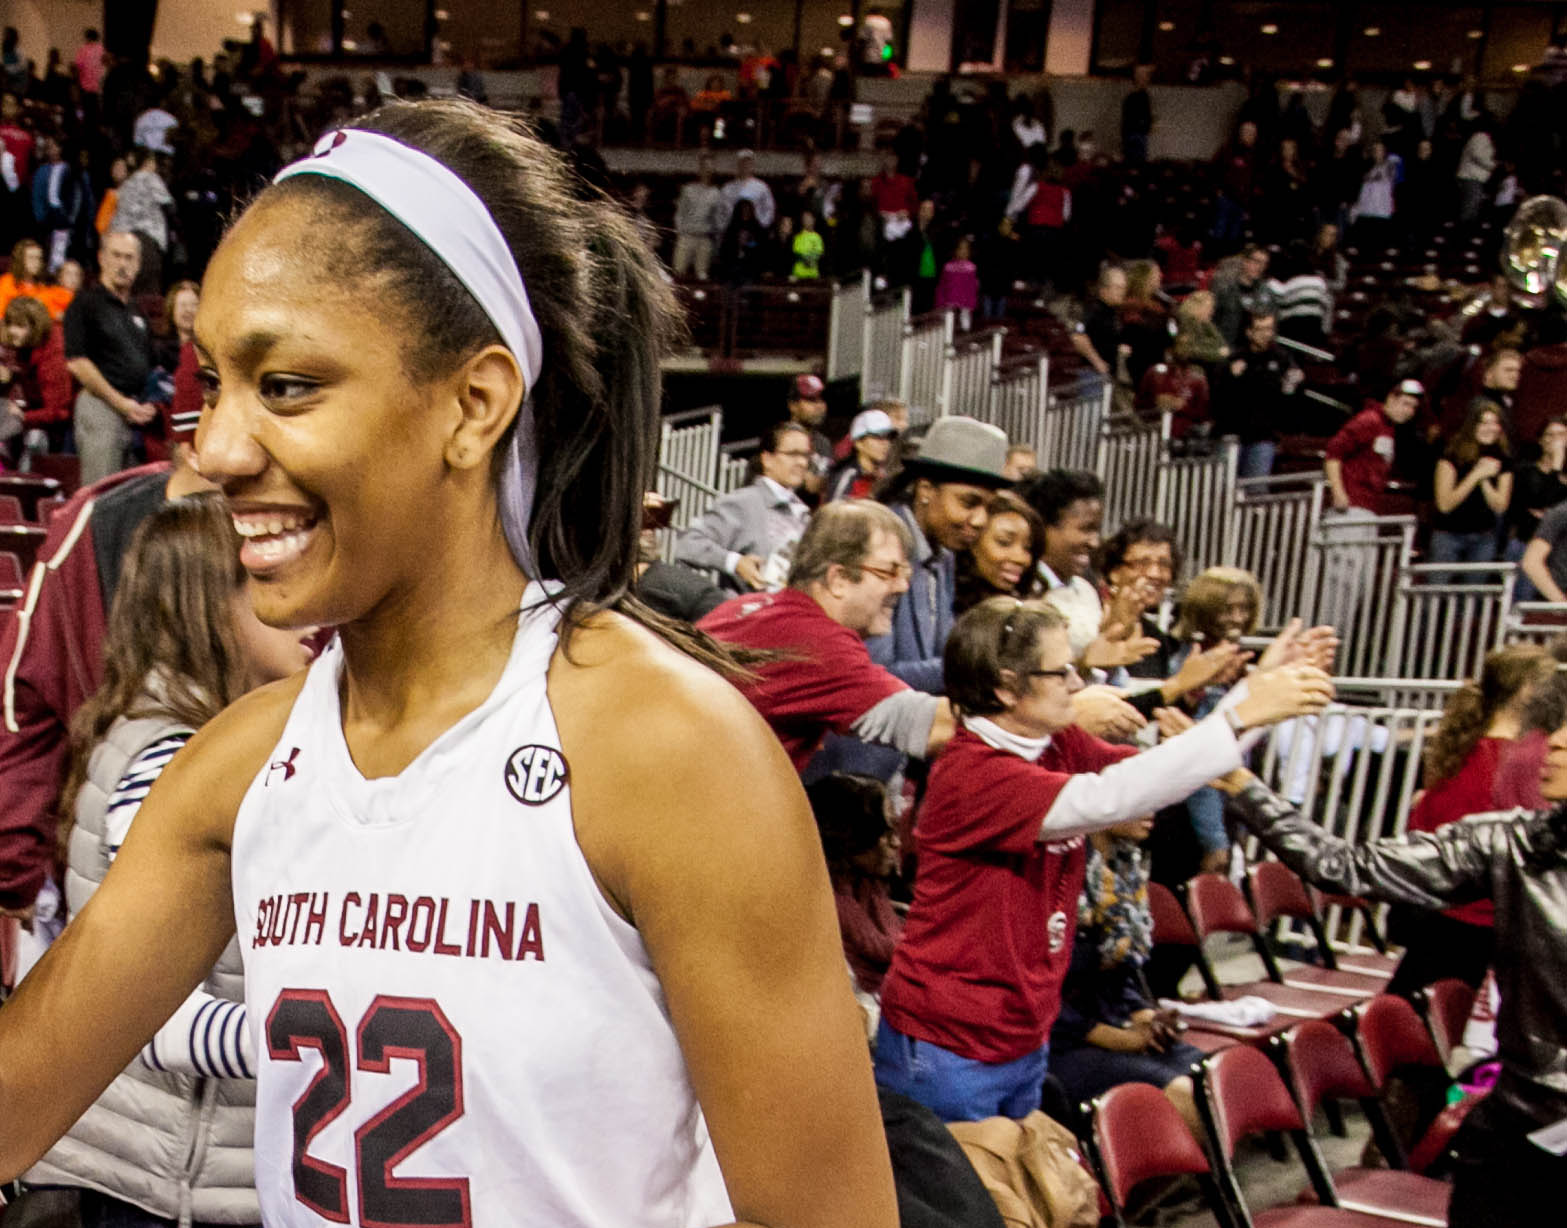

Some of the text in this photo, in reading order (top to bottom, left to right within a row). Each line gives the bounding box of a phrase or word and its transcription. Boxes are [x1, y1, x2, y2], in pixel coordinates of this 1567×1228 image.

[506, 745, 567, 802] SEC
[252, 891, 546, 962] SOUTH CAROLINA
